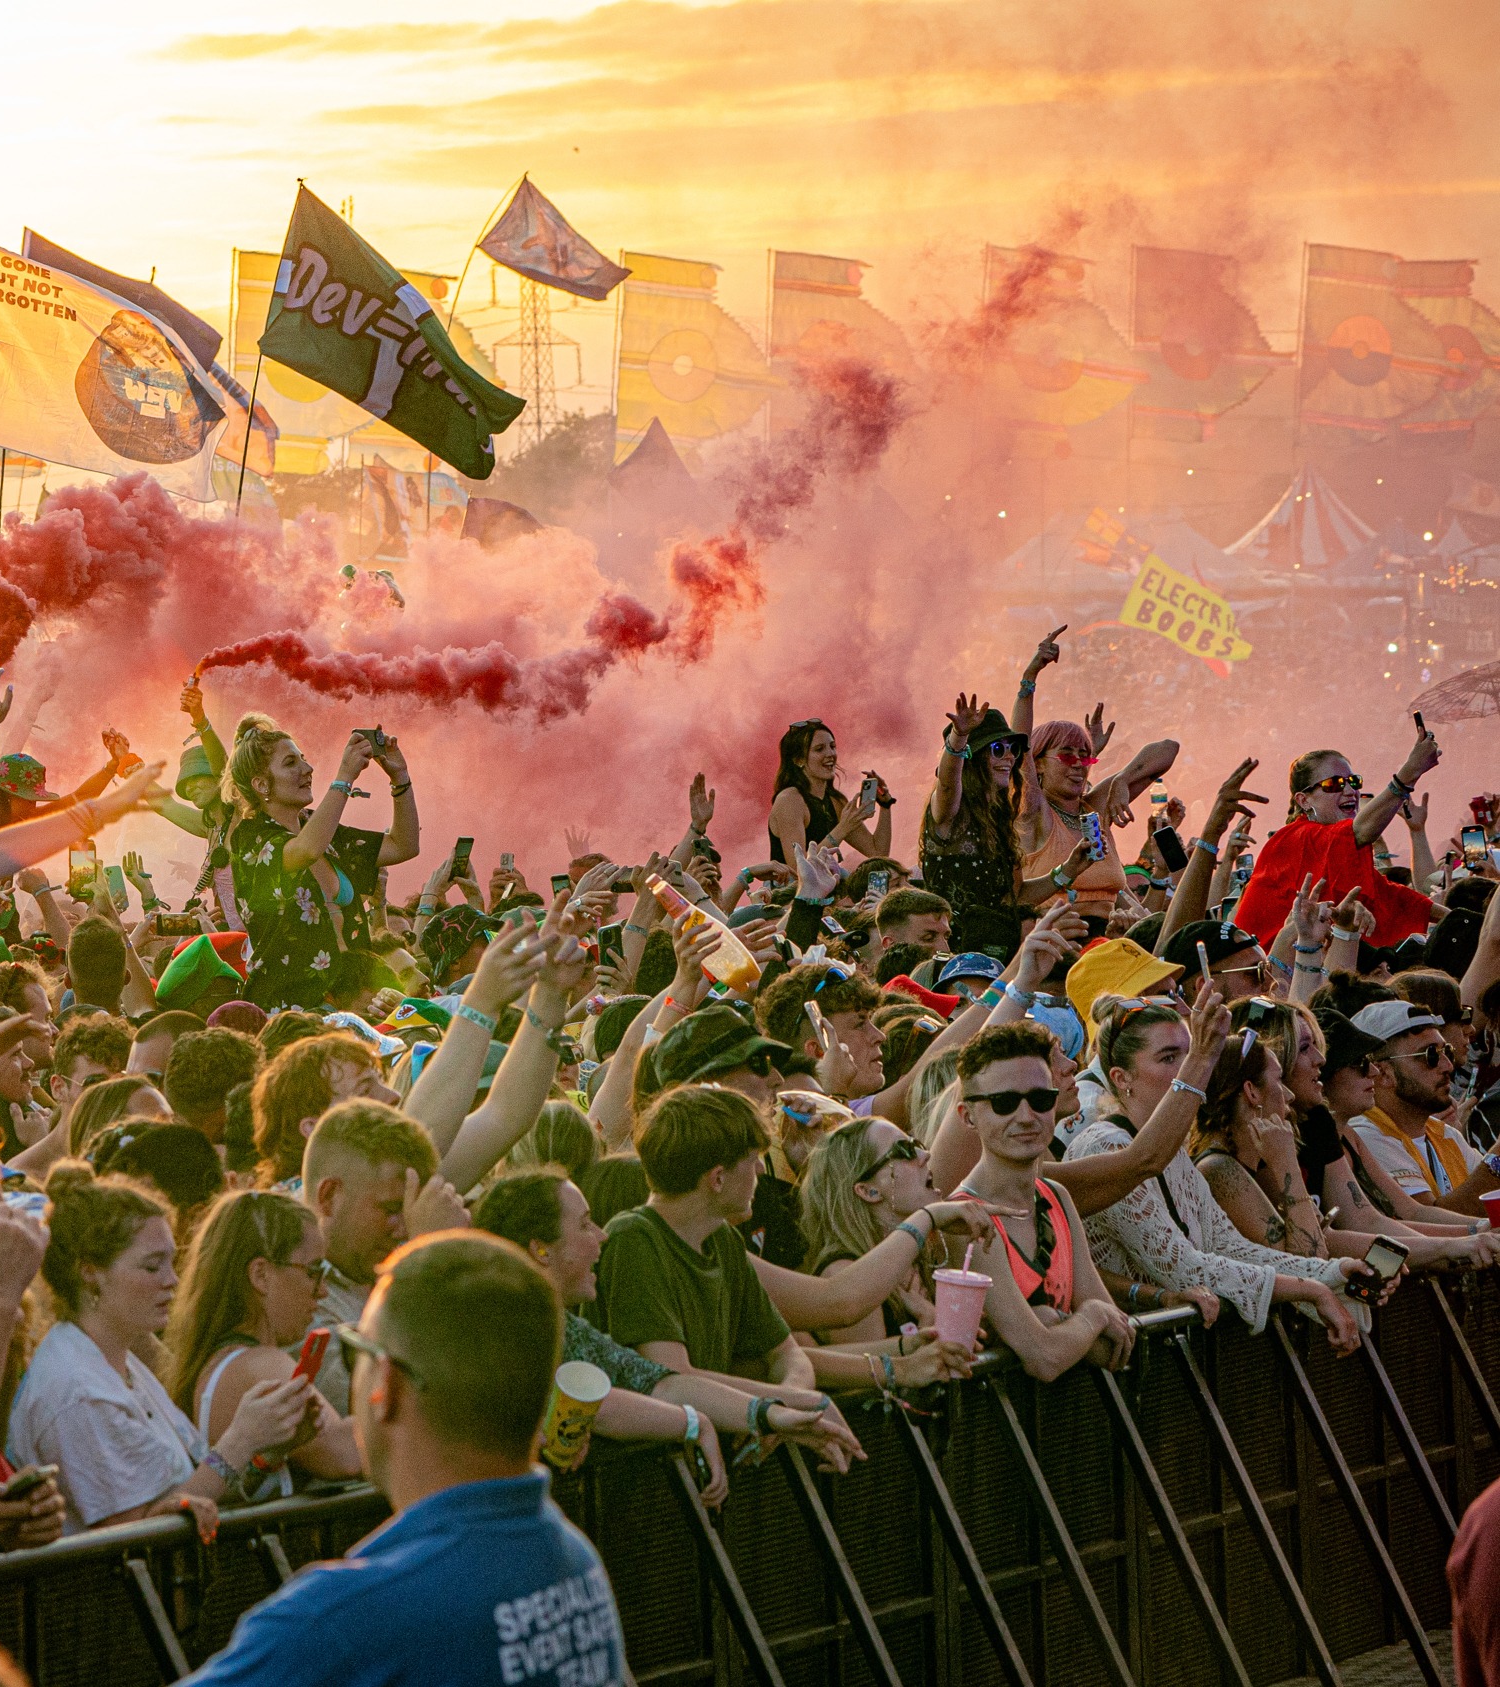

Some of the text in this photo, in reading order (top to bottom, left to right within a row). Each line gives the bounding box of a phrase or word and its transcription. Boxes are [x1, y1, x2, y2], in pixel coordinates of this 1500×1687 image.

[0, 255, 51, 280] GONE
[22, 277, 64, 299] NOT
[1136, 598, 1235, 656] BOOBS
[1140, 567, 1237, 633] ELECTRI
[493, 1571, 611, 1643] SPECIALI
[499, 1622, 573, 1685] EVENT
